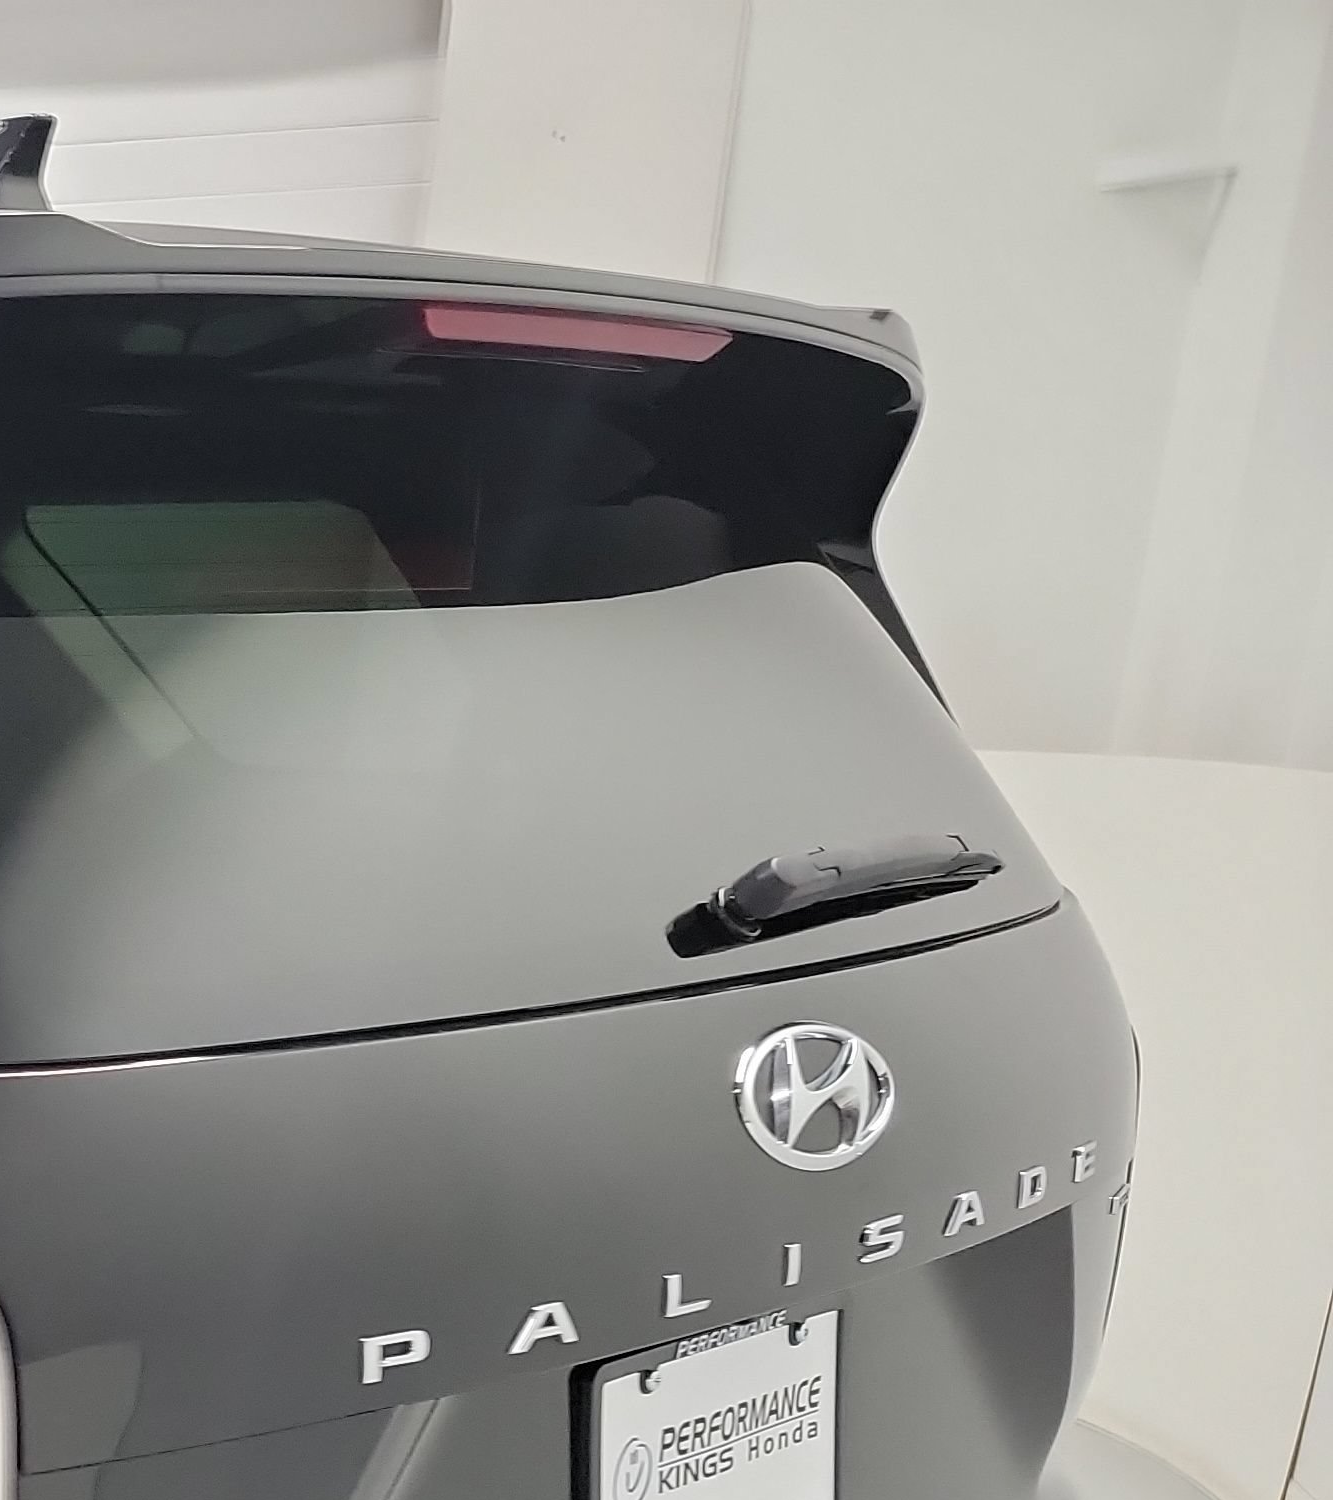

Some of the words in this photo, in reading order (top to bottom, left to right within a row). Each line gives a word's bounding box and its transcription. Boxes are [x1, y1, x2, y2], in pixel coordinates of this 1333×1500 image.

[358, 1139, 1098, 1385] PALISADE
[675, 1309, 788, 1360] PERFORMANCE
[658, 1447, 734, 1494] KINGS
[748, 1420, 818, 1462] Honda
[659, 1375, 822, 1463] PERFORMANCE
